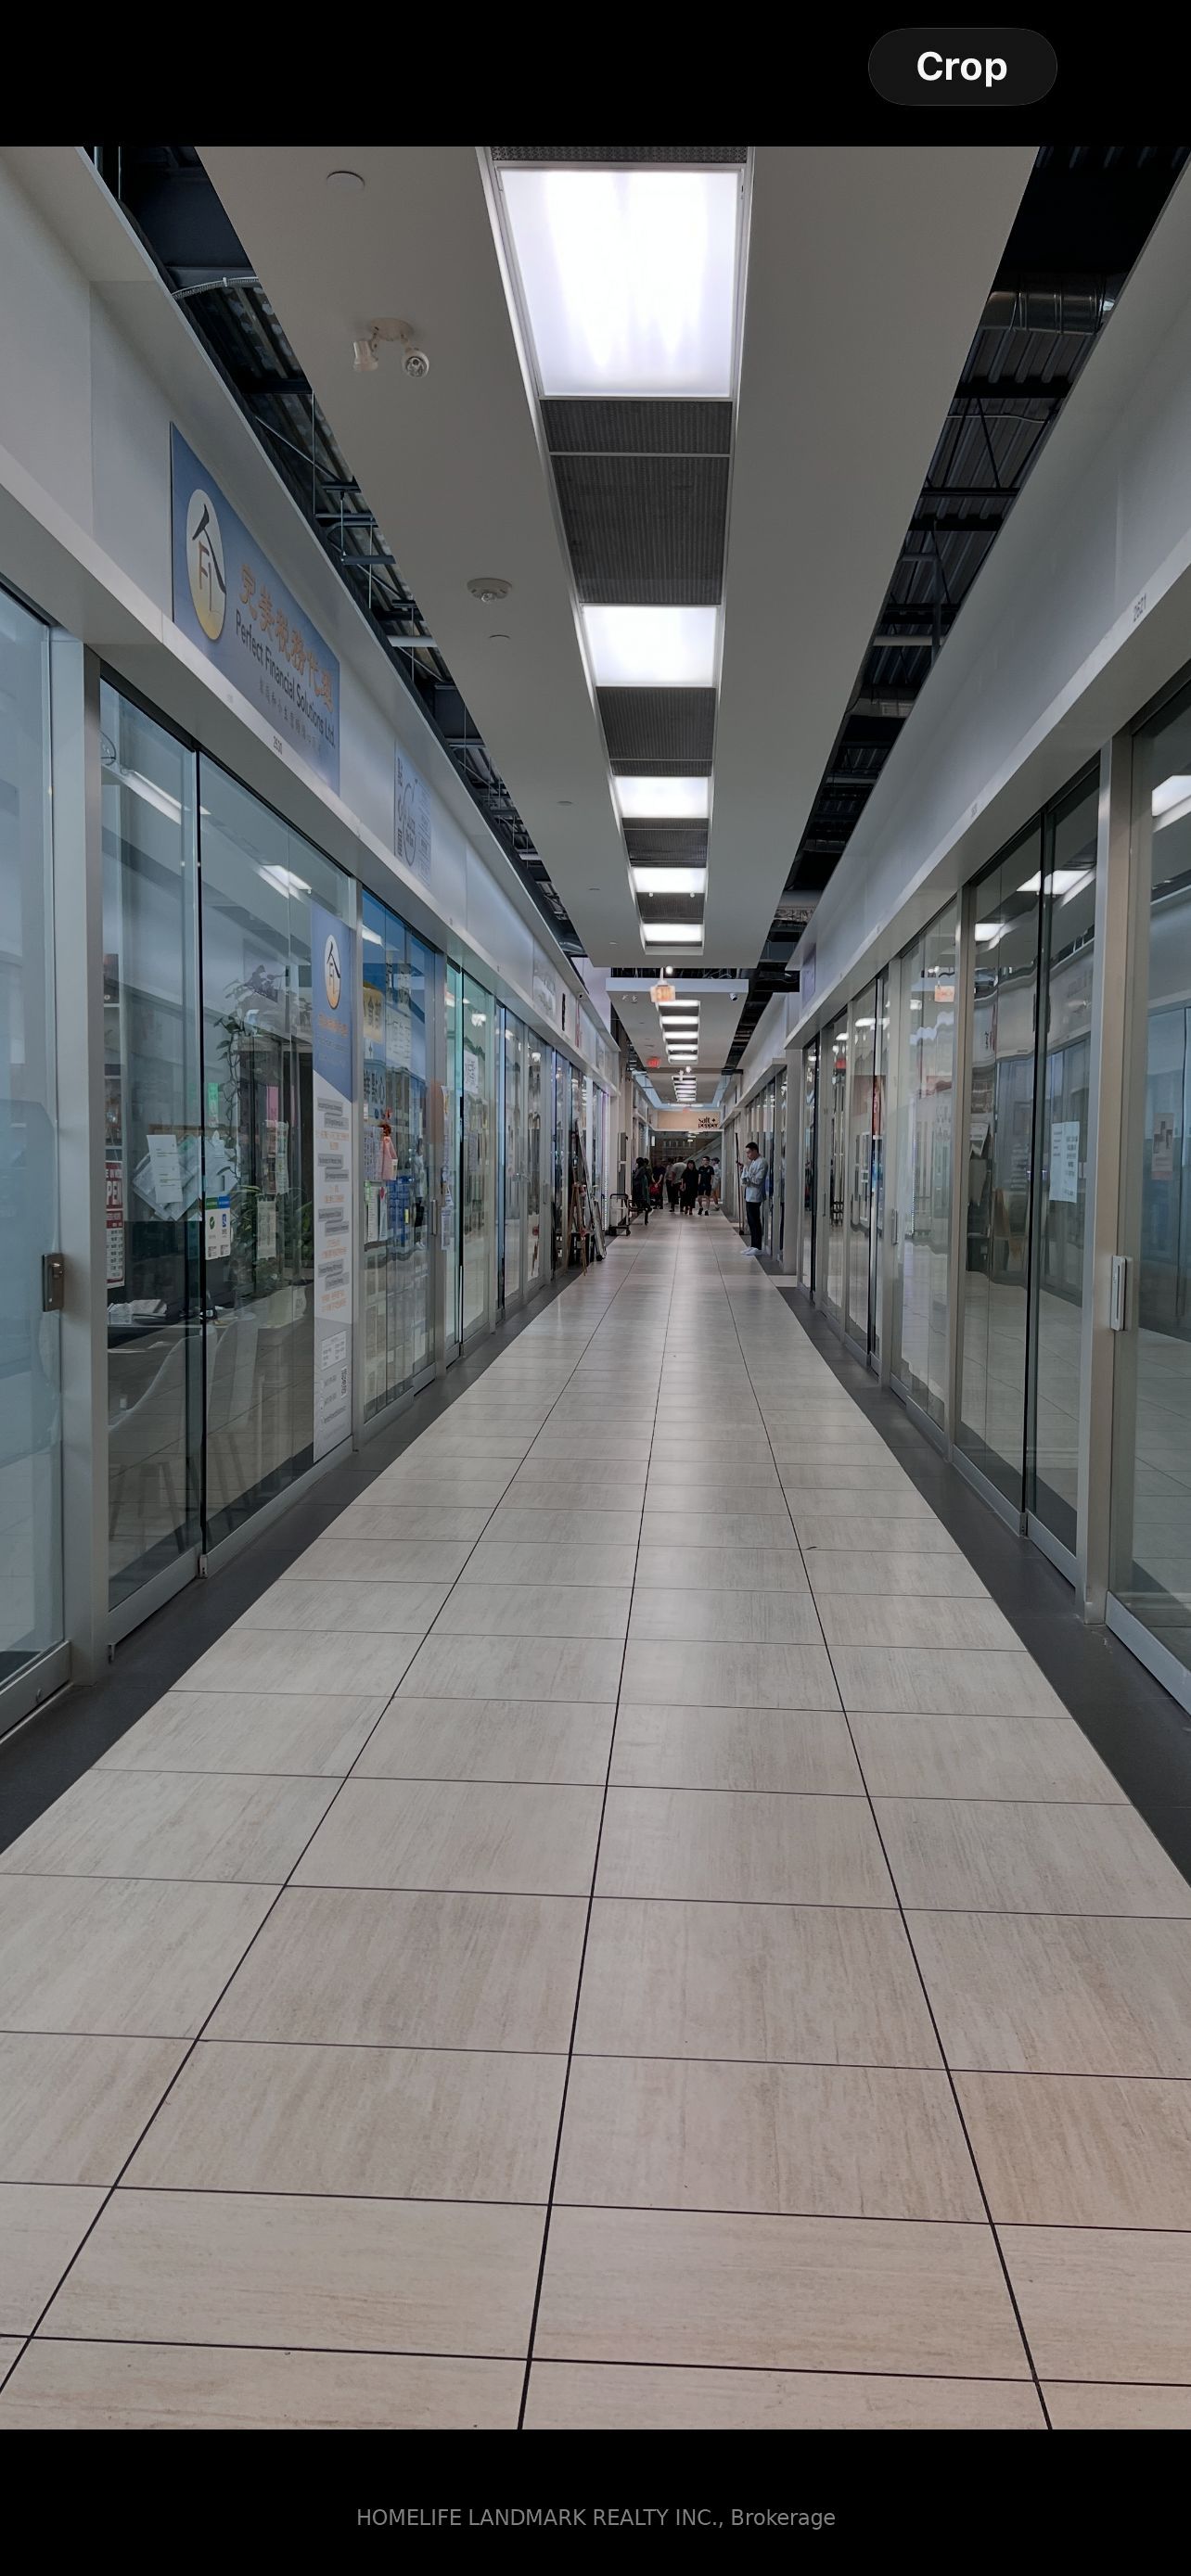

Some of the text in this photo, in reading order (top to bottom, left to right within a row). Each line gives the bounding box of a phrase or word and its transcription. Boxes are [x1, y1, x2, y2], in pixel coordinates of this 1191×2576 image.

[236, 608, 263, 666] Perfect
[265, 645, 295, 702] Financial
[296, 682, 324, 736] Solutions
[325, 714, 336, 748] Ltd.
